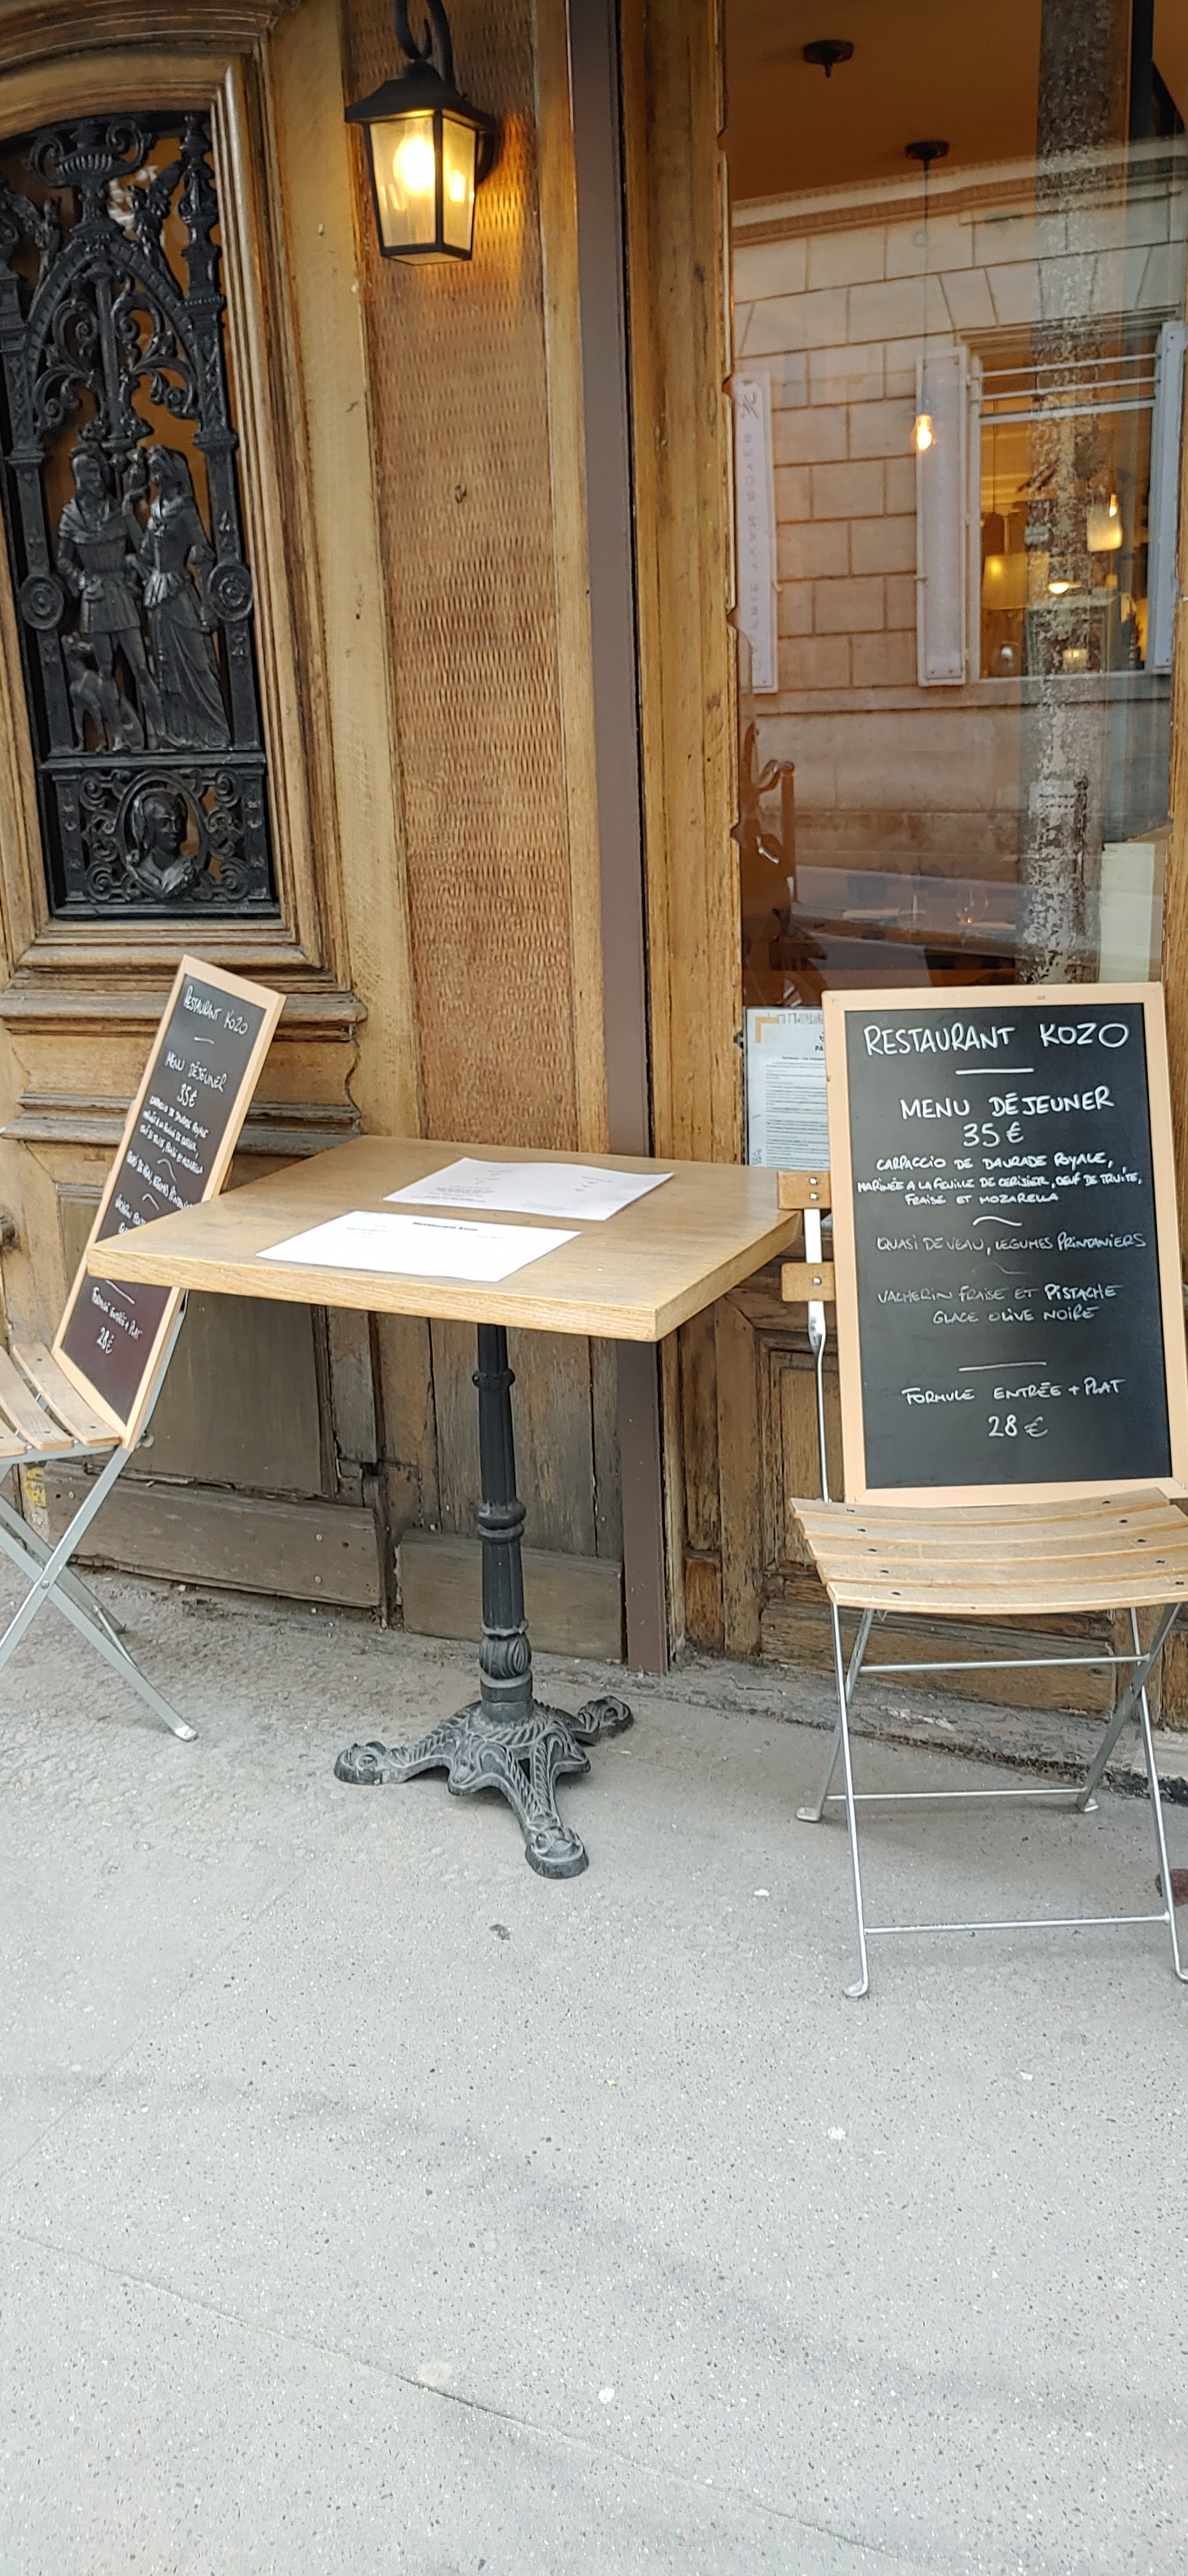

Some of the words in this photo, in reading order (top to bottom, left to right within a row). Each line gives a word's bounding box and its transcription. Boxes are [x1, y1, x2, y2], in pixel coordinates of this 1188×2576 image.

[183, 985, 222, 1020] RESTAURANT
[224, 1009, 248, 1034] KOZO
[864, 1023, 1016, 1055] RESTAURANT
[1039, 1022, 1129, 1048] KOZO
[165, 1050, 185, 1071] MENU
[900, 1098, 970, 1119] MENU
[988, 1085, 1115, 1117] DÉJEUNER
[876, 1155, 947, 1171] CARPACCIO
[954, 1158, 974, 1170] DE
[982, 1155, 1047, 1171] DAURADE
[1054, 1152, 1113, 1171] ROYALE,
[918, 1181, 933, 1190] LA
[979, 1177, 996, 1188] DE
[1083, 1174, 1099, 1186] DE
[904, 1193, 947, 1206] FRAISE
[956, 1195, 973, 1204] ET
[979, 1192, 1059, 1205] MOZARELLA
[877, 1234, 918, 1251] QUASI
[922, 1236, 943, 1250] DE
[995, 1236, 1053, 1250] LEGUMES
[1057, 1231, 1146, 1251] PRINTANIERS
[878, 1287, 952, 1303] VACHERIN
[958, 1285, 1009, 1303] FRAISE
[1014, 1287, 1039, 1300] ET
[1044, 1283, 1123, 1301] PISTACHE
[933, 1310, 979, 1324] GLACE
[988, 1308, 1035, 1322] OLIVE
[1043, 1303, 1100, 1321] NOIRE
[901, 1387, 975, 1405] FORMULE
[993, 1381, 1062, 1400] ENTRÉE
[1084, 1377, 1125, 1396] PLAT
